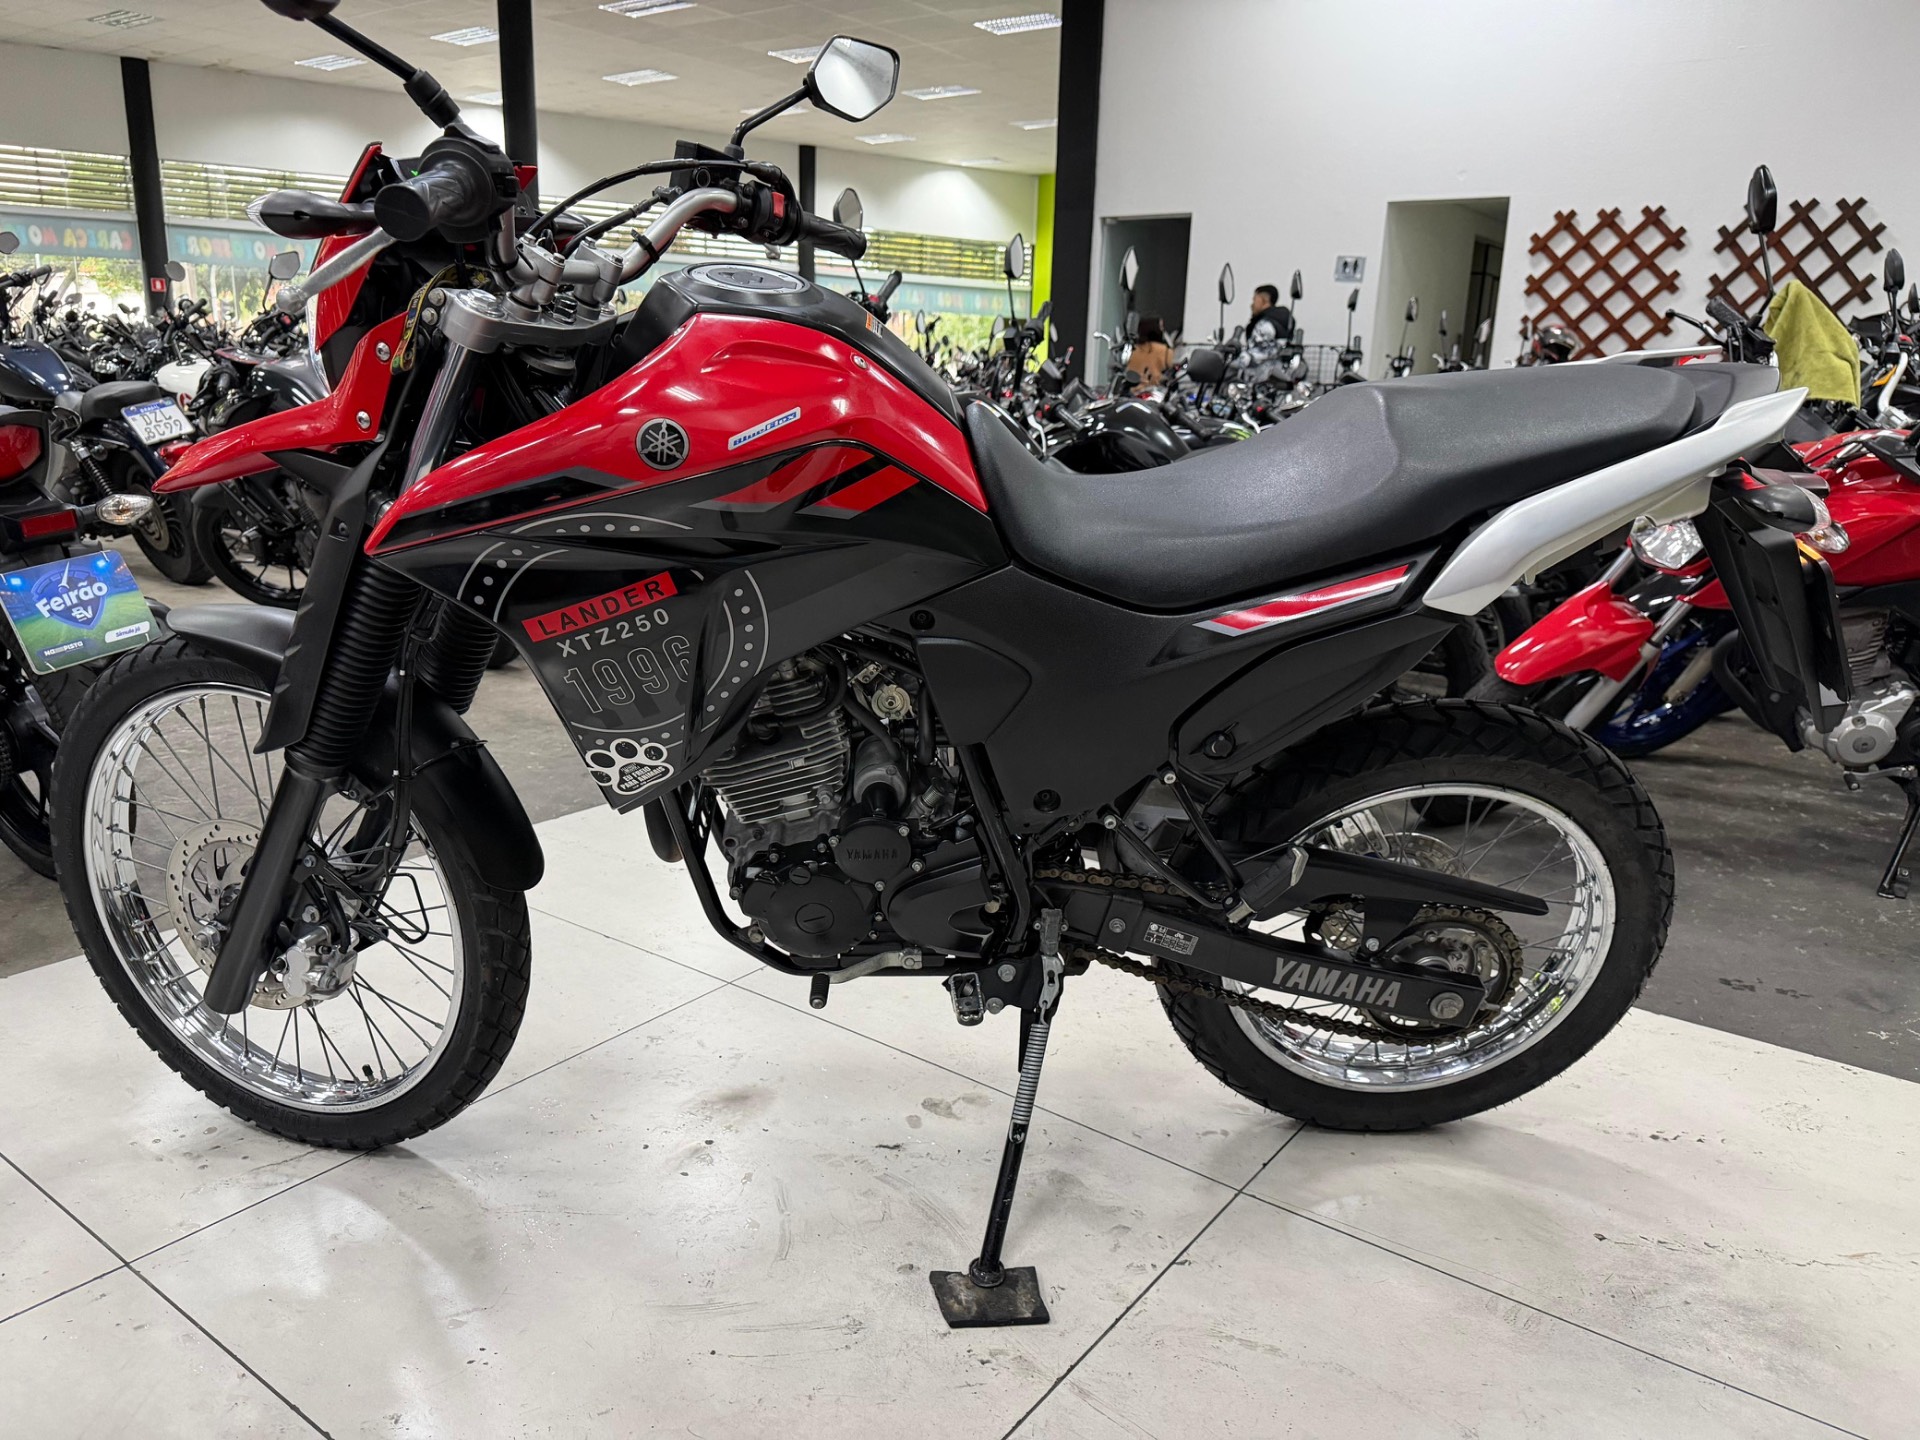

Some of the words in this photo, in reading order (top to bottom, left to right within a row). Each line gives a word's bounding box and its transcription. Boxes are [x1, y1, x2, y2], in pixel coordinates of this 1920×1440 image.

[140, 410, 172, 426] DZL
[35, 580, 108, 618] Feirão
[537, 580, 665, 636] LANDER
[556, 608, 669, 658] XTZ250
[563, 635, 690, 714] 1996
[846, 848, 899, 860] YAMAHA
[1272, 956, 1402, 1008] YAMAHA
